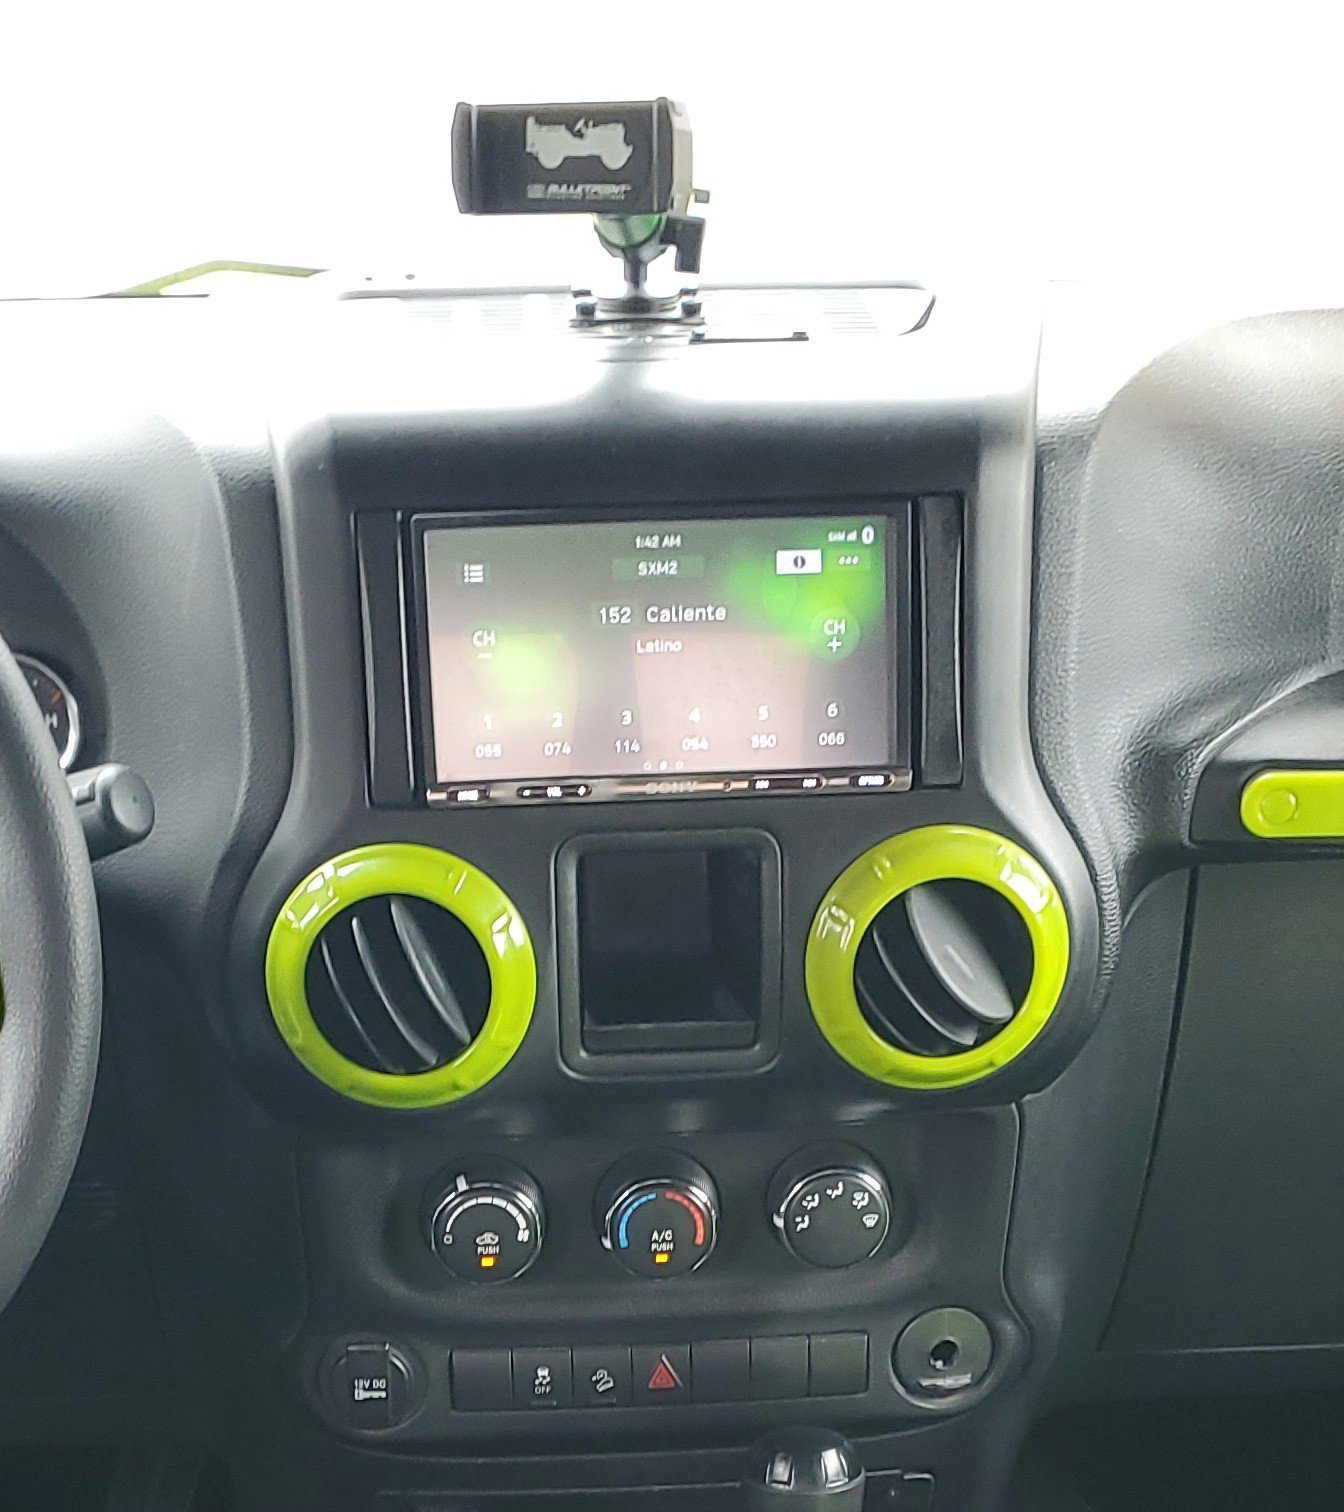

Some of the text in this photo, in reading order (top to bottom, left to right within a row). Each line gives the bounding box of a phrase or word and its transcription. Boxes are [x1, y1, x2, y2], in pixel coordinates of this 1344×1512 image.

[661, 533, 682, 548] AM
[637, 560, 679, 576] SXM2
[599, 604, 727, 624] 152 Caliente
[823, 618, 846, 636] CH
[472, 629, 496, 647] CH
[636, 638, 683, 654] Latino
[483, 702, 839, 730] 1 2 3 4 5 6
[544, 741, 572, 756] 074
[614, 738, 641, 754] 114
[651, 1229, 673, 1243] A/C
[477, 1245, 500, 1255] PUSH
[651, 1242, 674, 1253] PUSH
[534, 1385, 552, 1395] OFF
